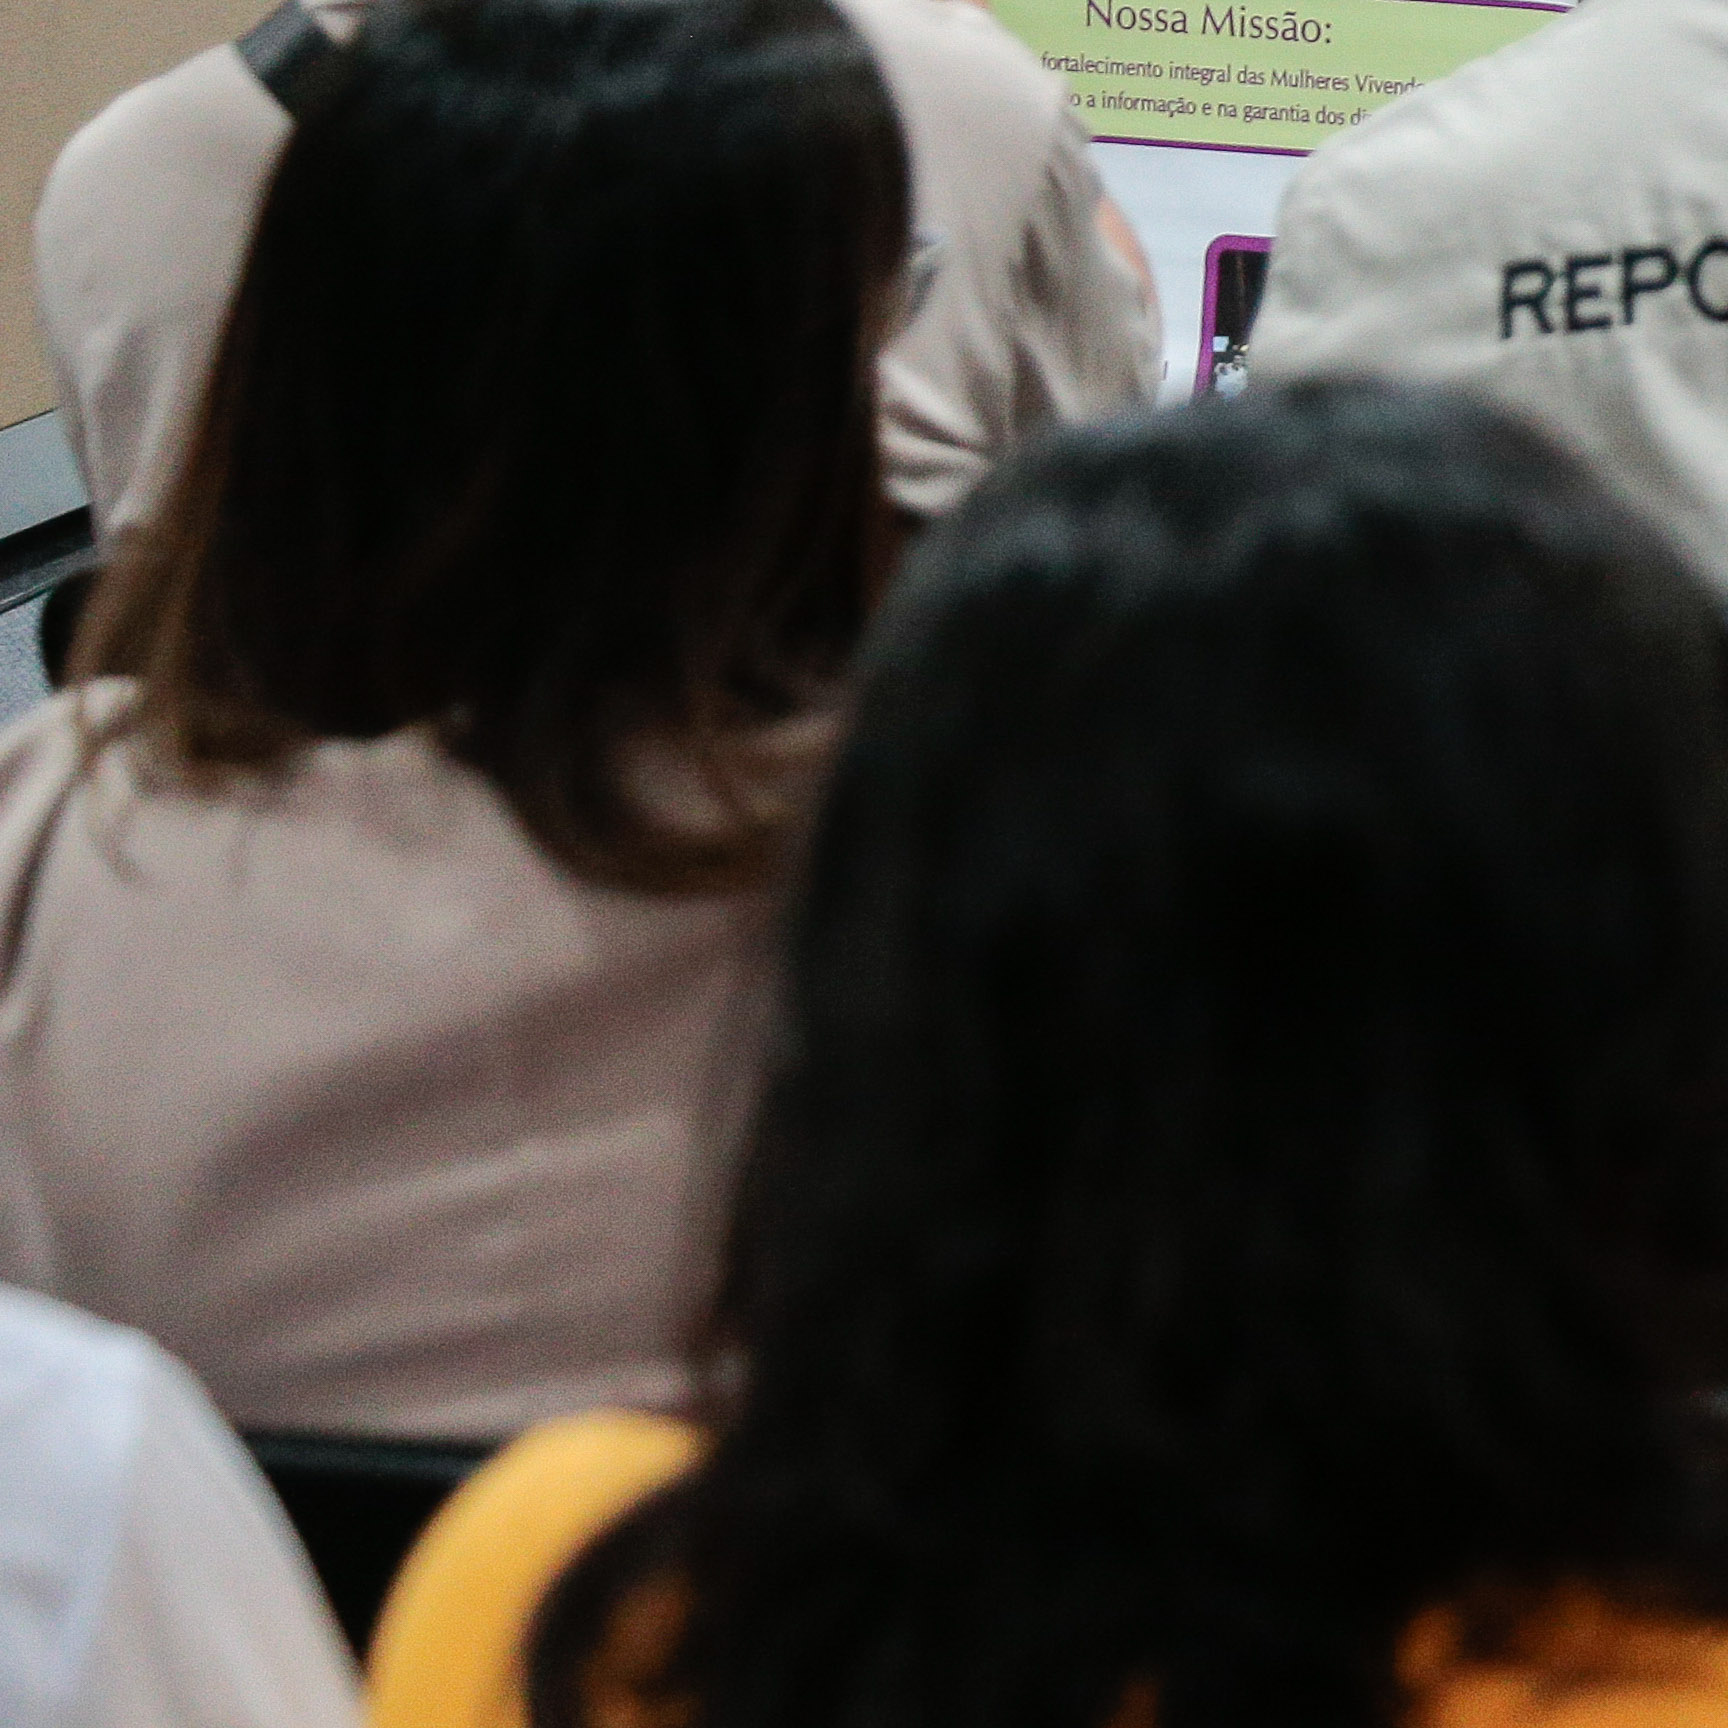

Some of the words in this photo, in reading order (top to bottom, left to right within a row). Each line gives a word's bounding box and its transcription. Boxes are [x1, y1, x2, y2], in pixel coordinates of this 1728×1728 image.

[1201, 3, 1332, 44] Missão:
[1041, 51, 1164, 78] fortalecimento
[1168, 60, 1231, 86] integral
[1236, 65, 1265, 86] das
[1271, 69, 1350, 92] Mulheres
[1355, 74, 1425, 96] Vivend
[1086, 94, 1096, 108] a
[1101, 90, 1197, 118] informação
[1201, 101, 1212, 116] e
[1217, 102, 1238, 118] na
[1243, 103, 1310, 123] garantia
[1315, 105, 1345, 125] dos
